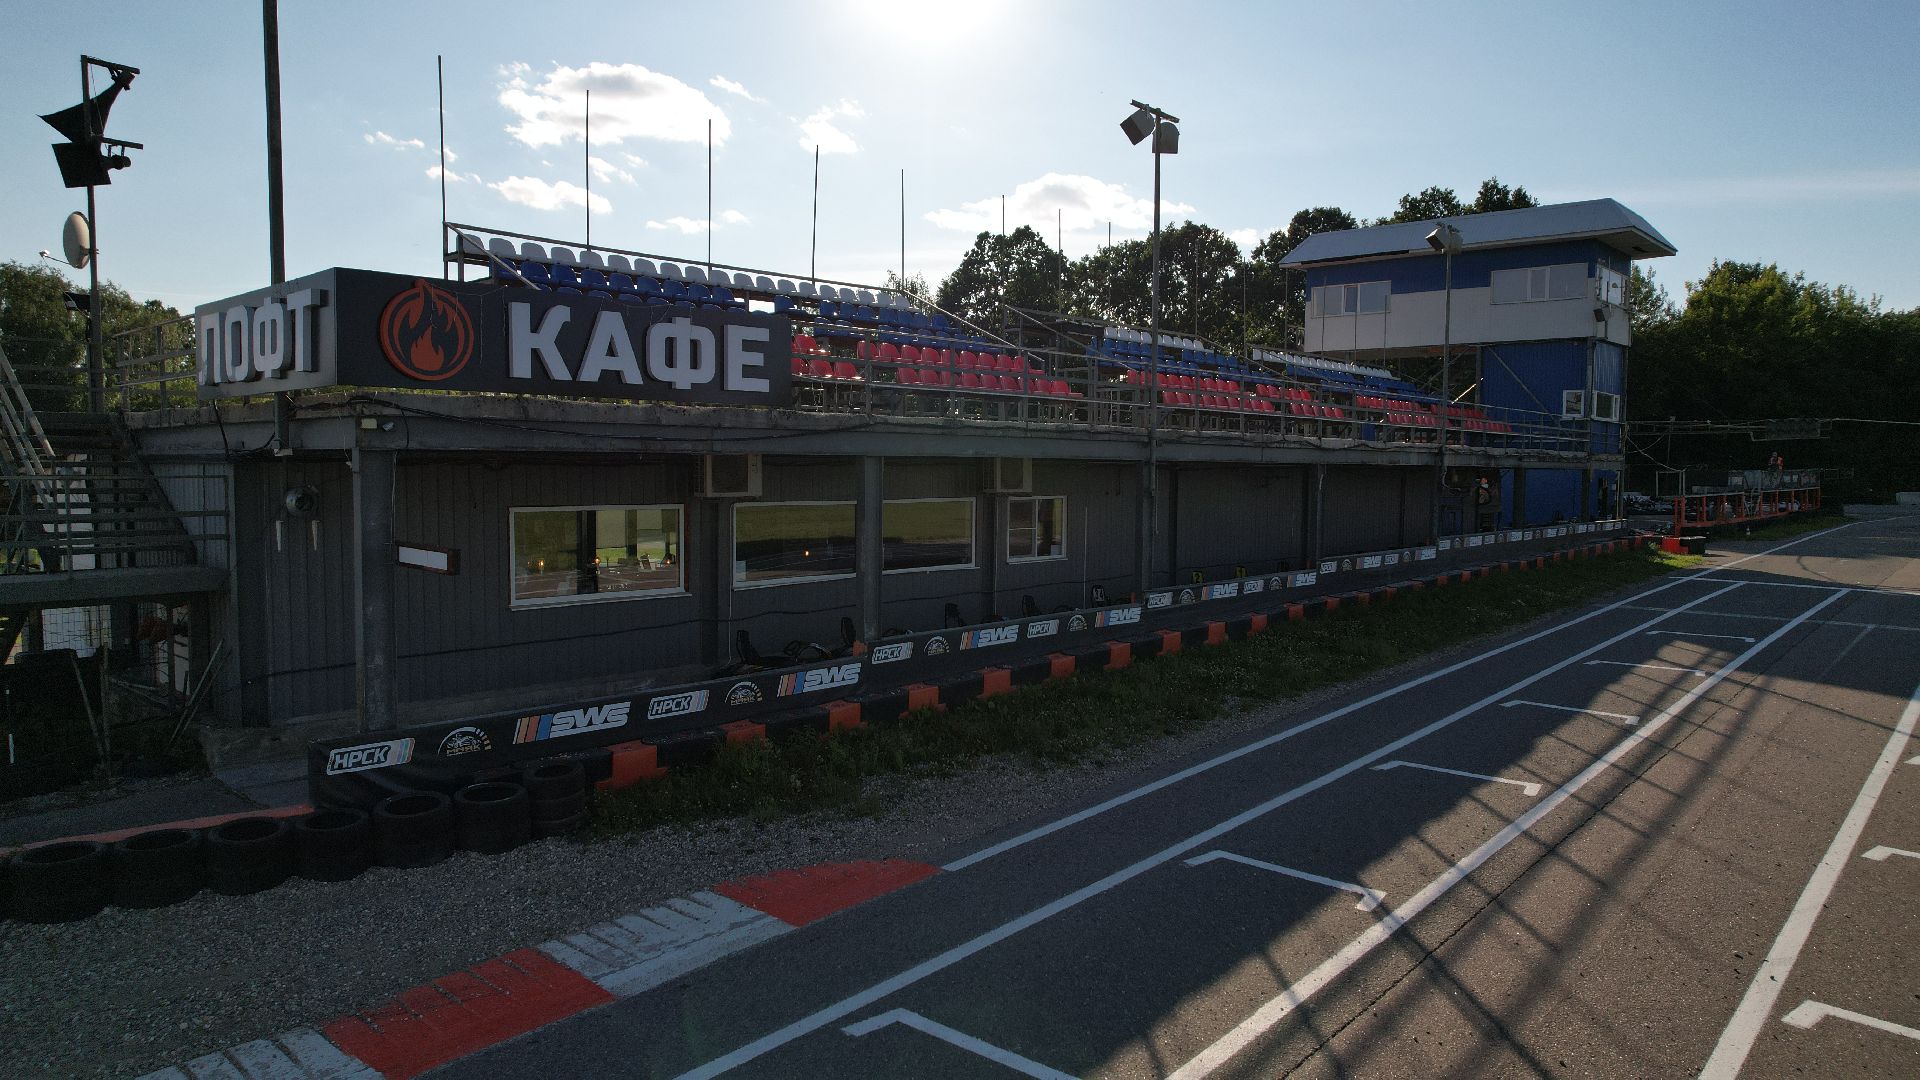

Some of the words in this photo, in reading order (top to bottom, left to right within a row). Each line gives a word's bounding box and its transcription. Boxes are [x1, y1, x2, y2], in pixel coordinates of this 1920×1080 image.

[198, 288, 318, 386] ЛОФТ
[508, 301, 770, 392] КАФЕ
[1109, 607, 1142, 626] SWS
[977, 624, 1020, 648] SWS
[803, 662, 862, 693] SWS
[550, 701, 632, 739] SWS
